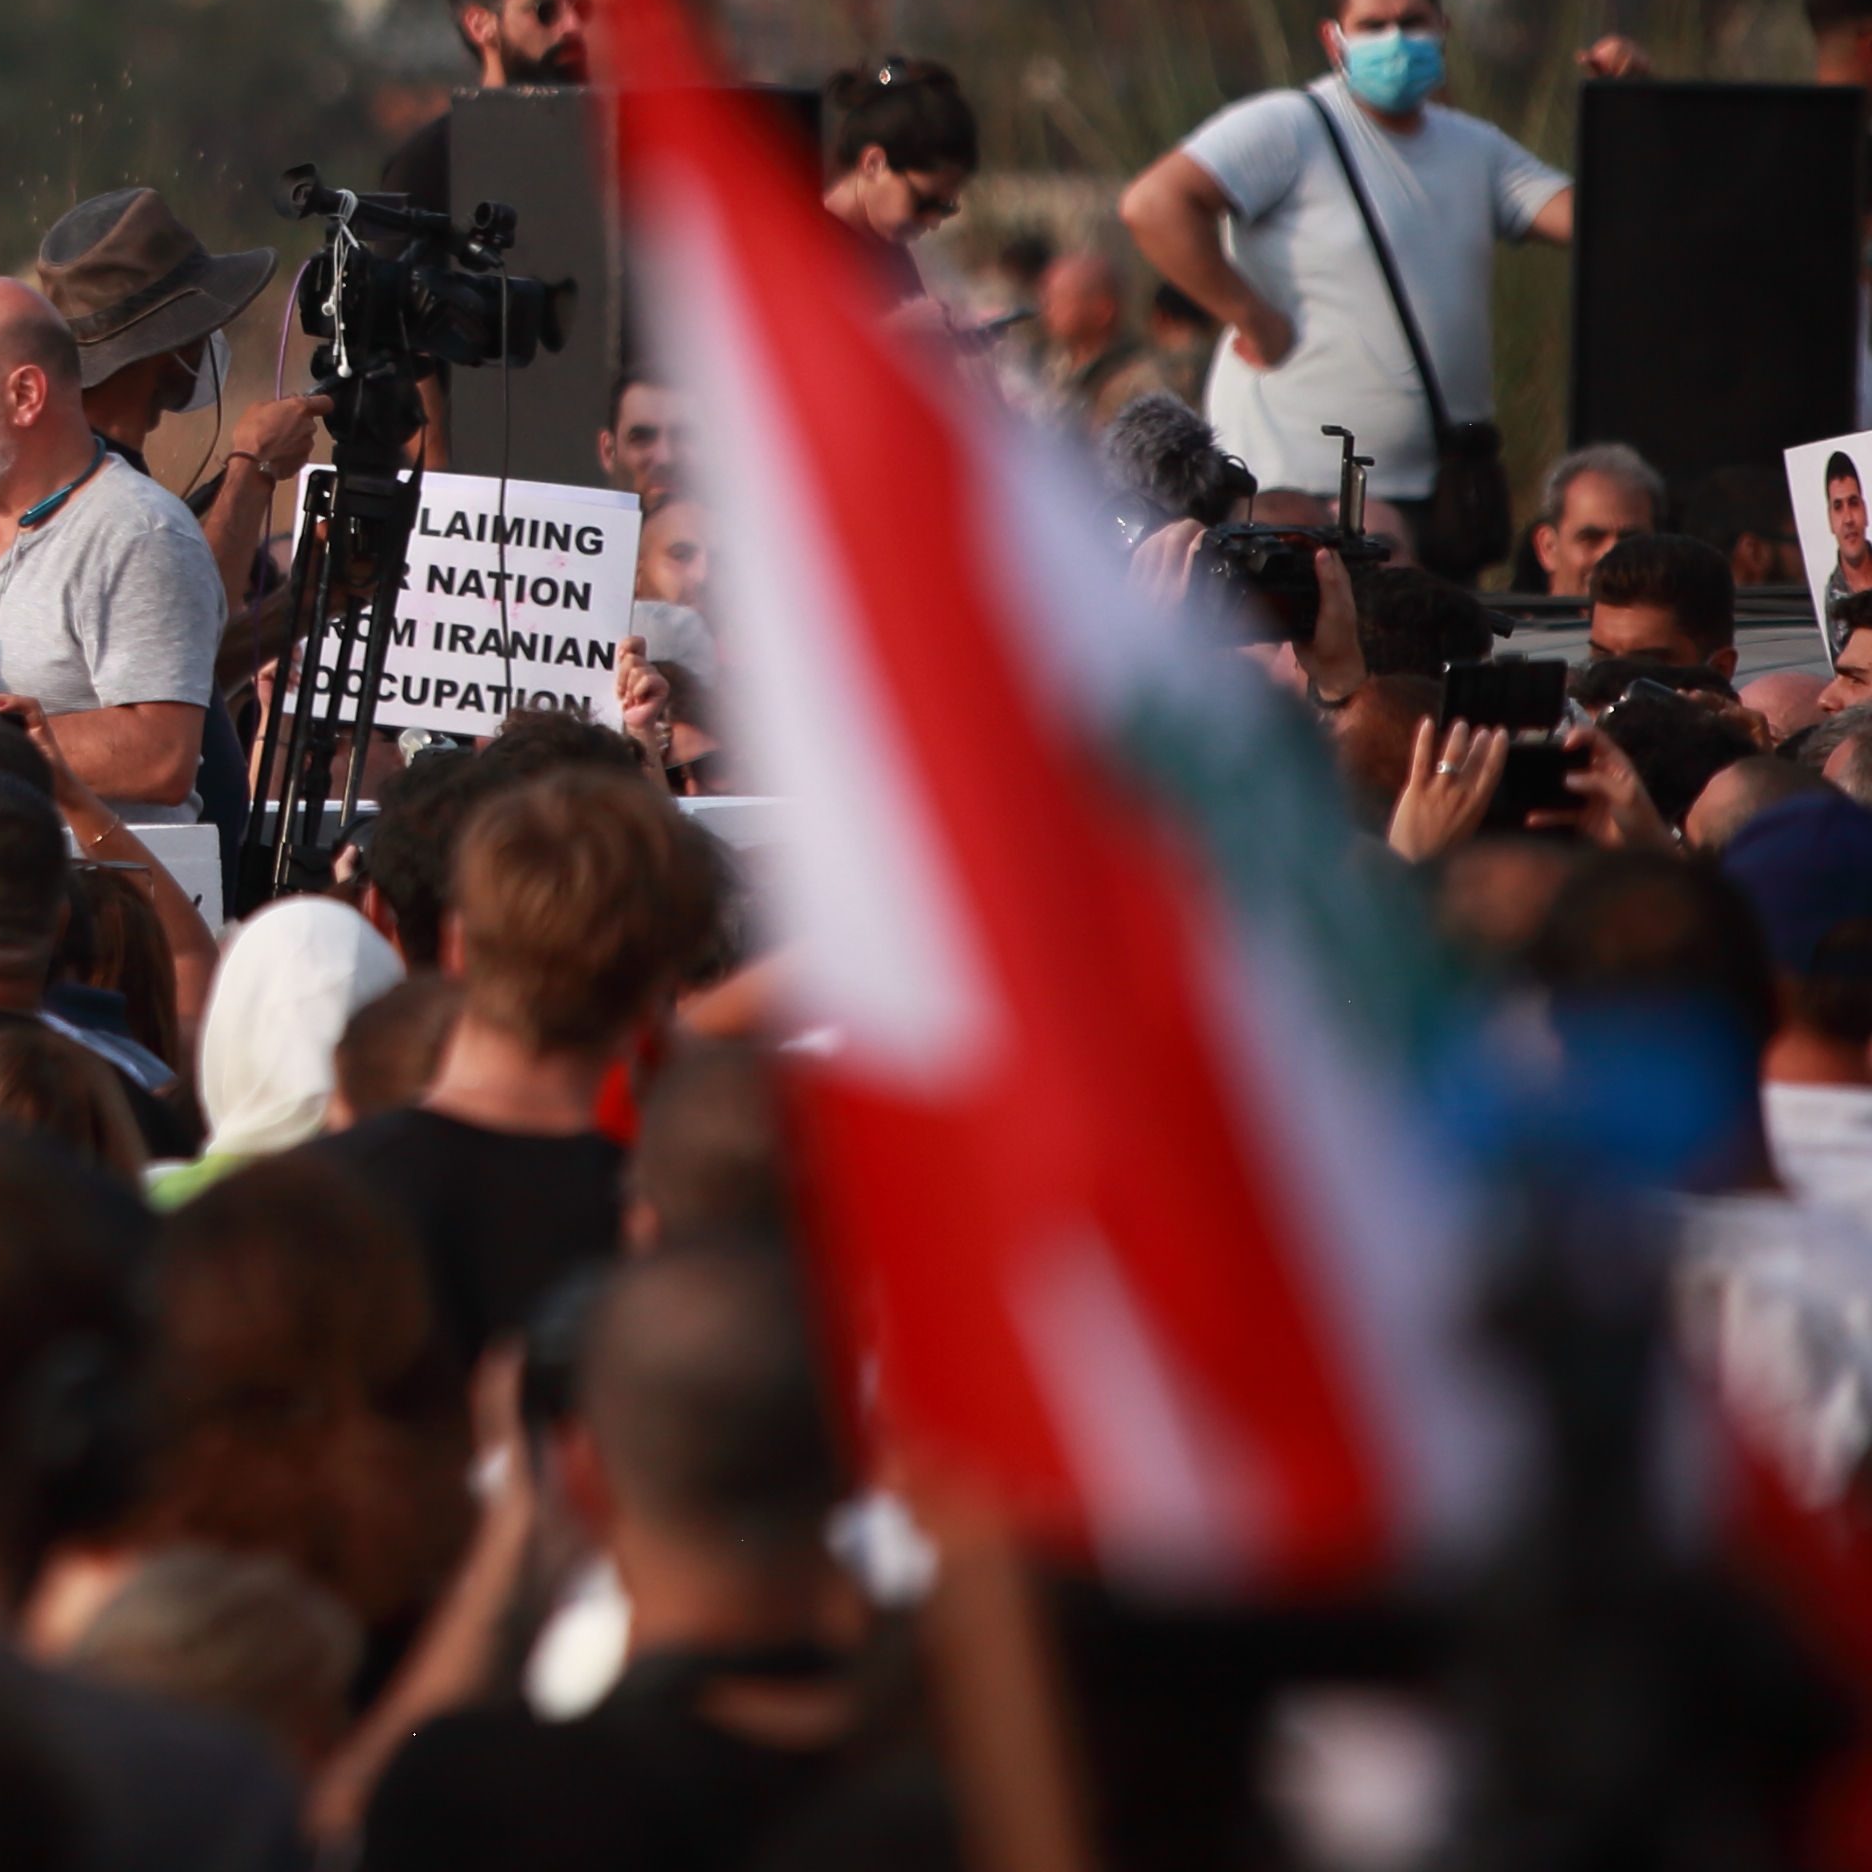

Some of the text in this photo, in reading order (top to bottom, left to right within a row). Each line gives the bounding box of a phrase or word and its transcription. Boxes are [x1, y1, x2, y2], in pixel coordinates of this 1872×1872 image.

[419, 507, 605, 556] LAIMING
[426, 564, 592, 611] NATION
[324, 612, 617, 671] ROM IRANIAN
